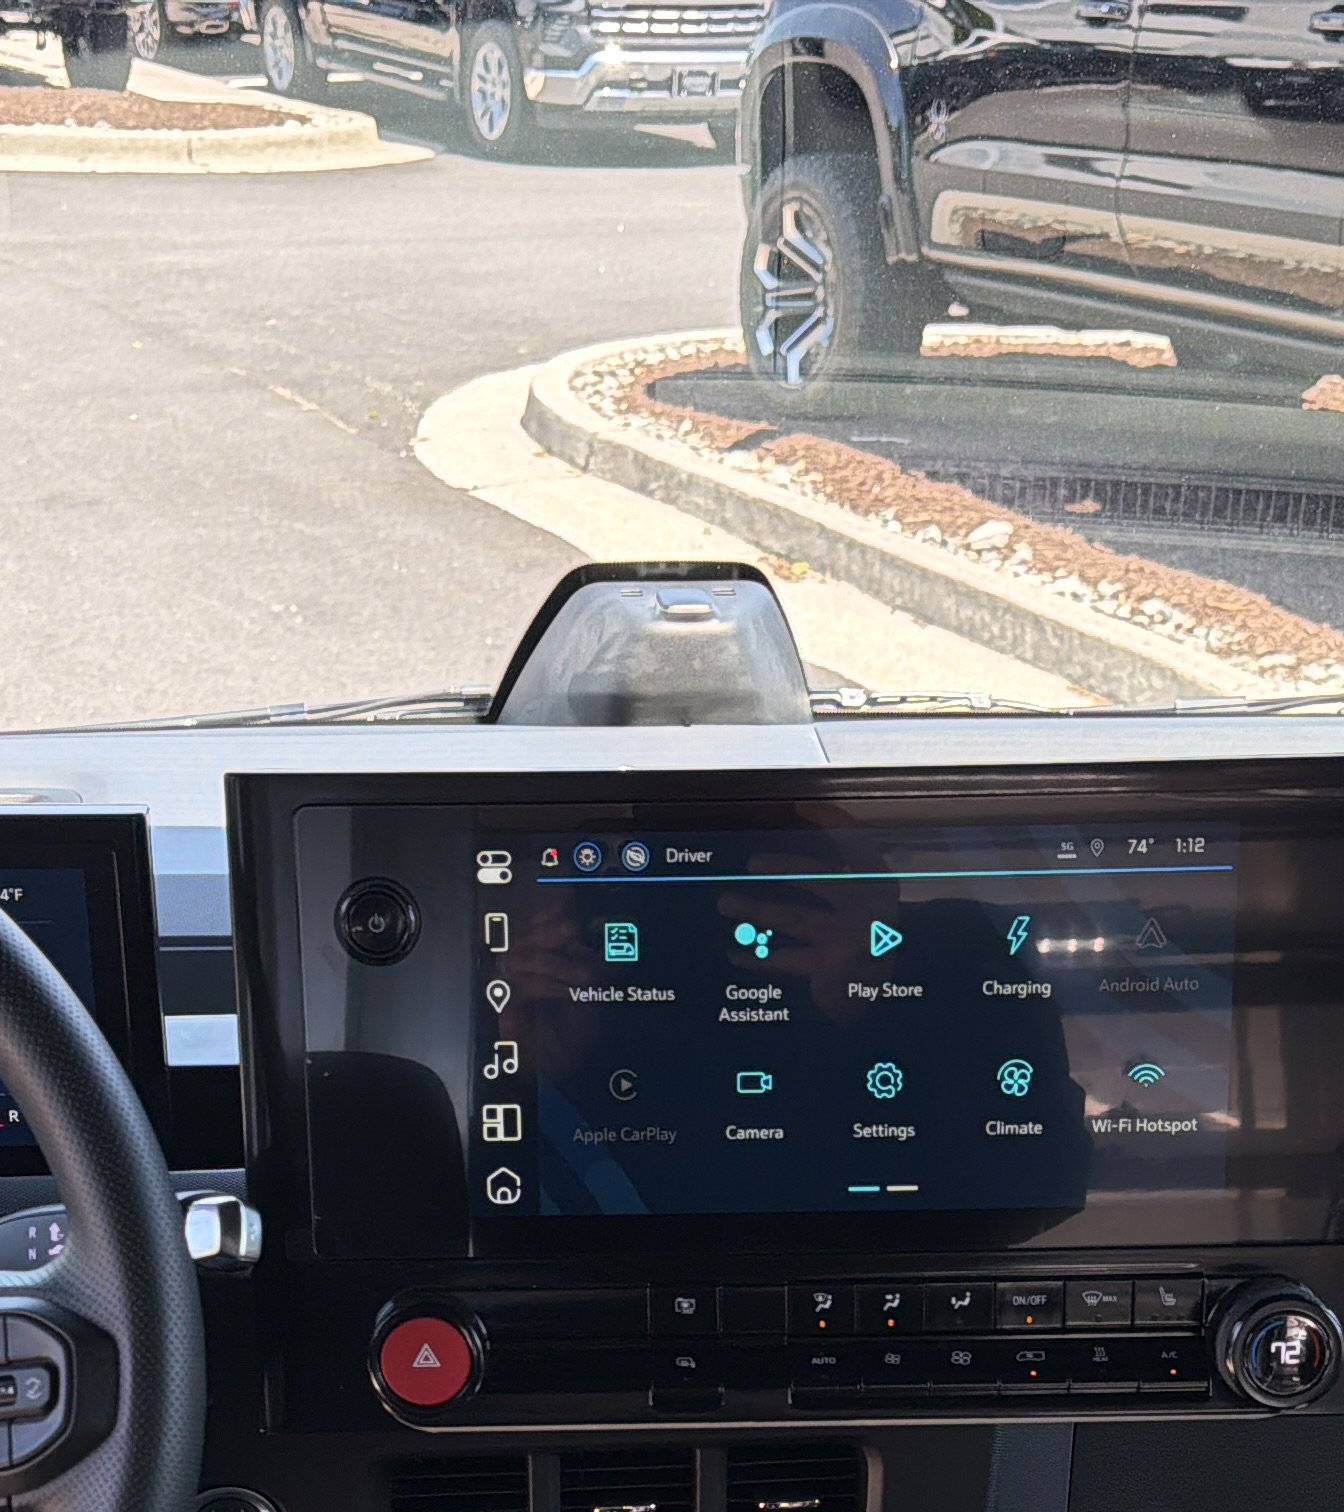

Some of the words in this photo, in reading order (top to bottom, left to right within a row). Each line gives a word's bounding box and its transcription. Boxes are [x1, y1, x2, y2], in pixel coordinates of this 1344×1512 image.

[1127, 838, 1155, 855] 74°
[1175, 837, 1206, 854] 1:12
[666, 848, 713, 864] Driver
[848, 982, 879, 1000] Play
[882, 982, 924, 998] Store
[982, 980, 1052, 998] Charging
[1099, 976, 1161, 993] Android
[1164, 976, 1200, 992] Auto
[569, 986, 624, 1003] Vehicle
[627, 986, 676, 1002] Status
[725, 984, 782, 1004] Google
[719, 1006, 790, 1023] Assistant
[8, 1110, 21, 1123] R
[725, 1124, 785, 1141] Camera
[852, 1122, 916, 1141] Settings
[985, 1120, 1044, 1136] Climate
[1092, 1117, 1133, 1134] Wi-Fi
[1135, 1117, 1198, 1135] Hotspot
[572, 1126, 617, 1145] Apple
[620, 1125, 678, 1145] CarPlay
[28, 1226, 36, 1239] R
[28, 1248, 36, 1261] N
[1012, 1294, 1048, 1306] ON/OFF
[1102, 1295, 1119, 1303] MAX
[811, 1356, 837, 1366] AUTO
[1160, 1350, 1179, 1360] A/C
[1269, 1340, 1302, 1366] 72
